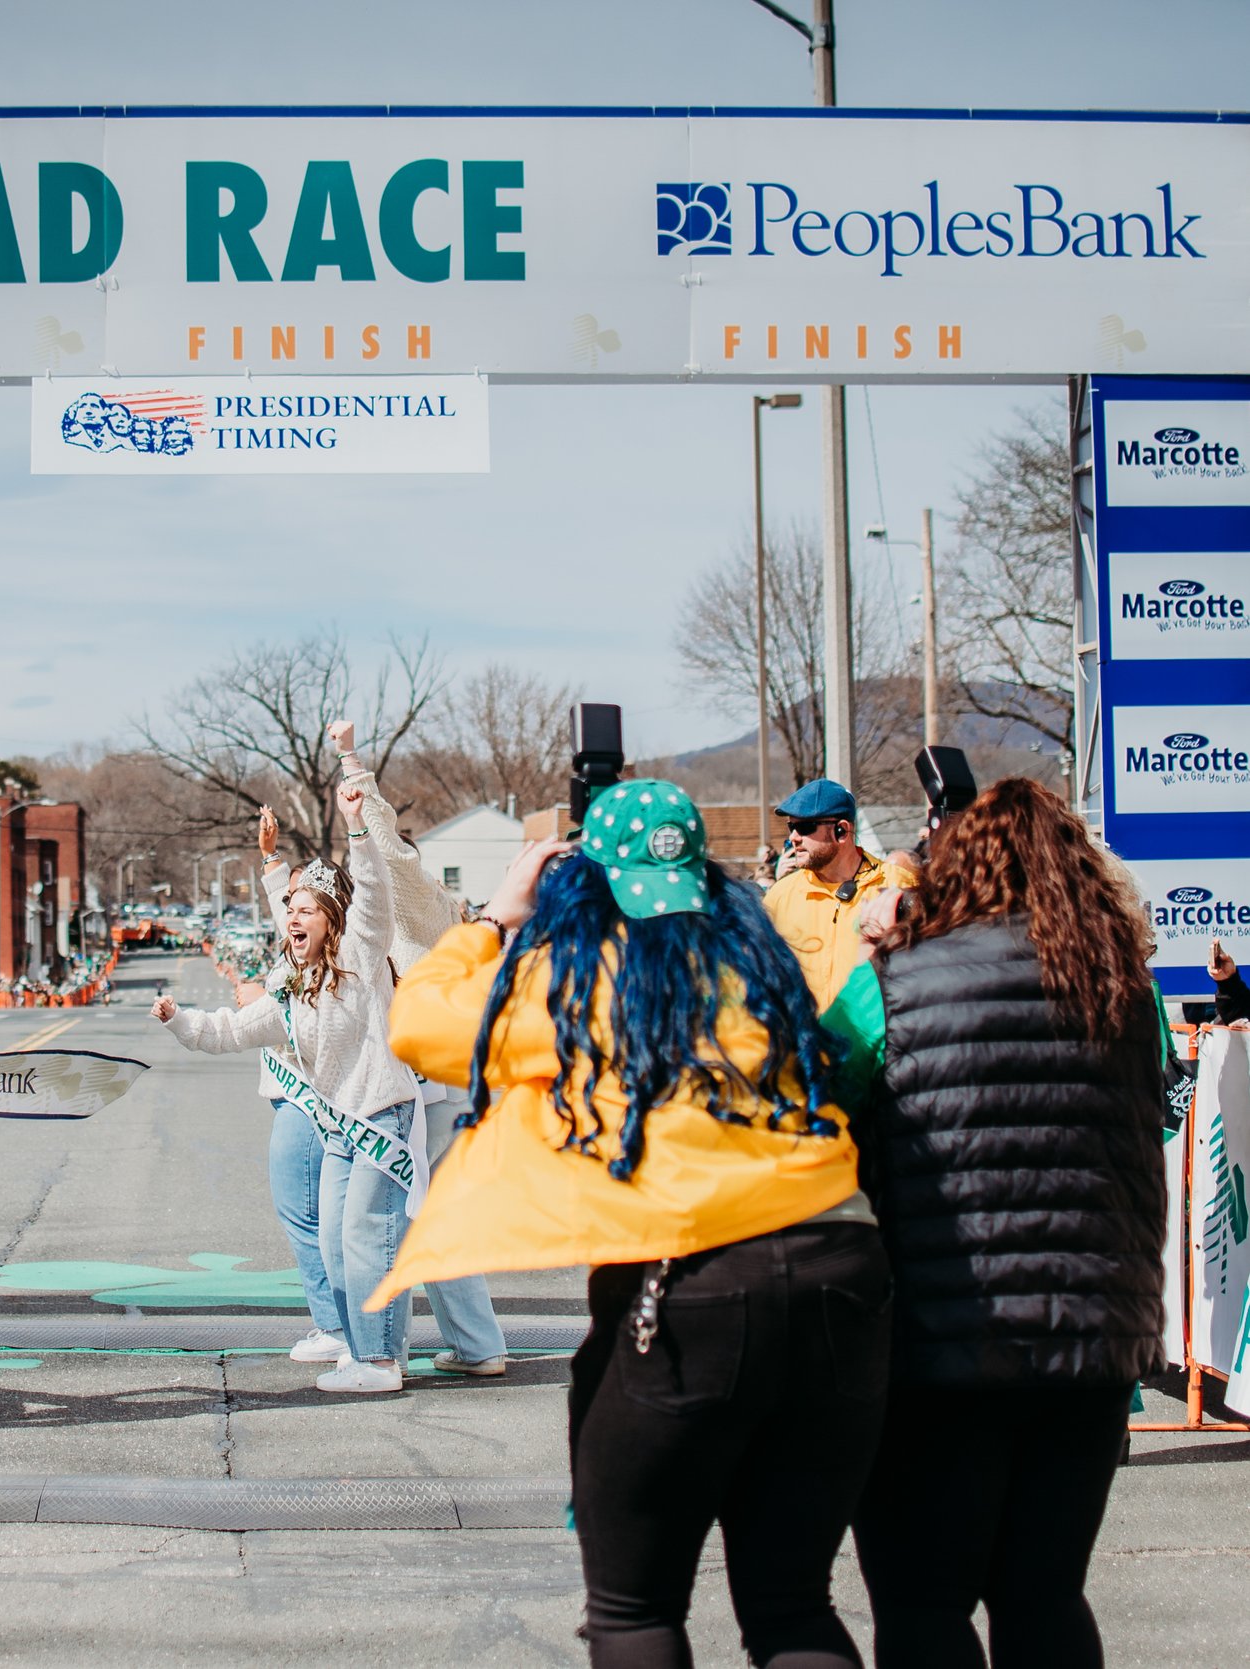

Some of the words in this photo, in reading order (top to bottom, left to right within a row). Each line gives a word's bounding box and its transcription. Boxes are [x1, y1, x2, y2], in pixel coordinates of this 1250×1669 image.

[186, 158, 526, 283] RACE
[747, 180, 1208, 277] PeoplesBank
[188, 324, 432, 360] FINISH
[724, 324, 962, 360] FINISH
[214, 395, 457, 418] PRESIDENTIAL
[211, 427, 338, 449] TIMING
[1117, 440, 1240, 466] Marcotte
[1122, 593, 1244, 619] Marcotte
[1126, 747, 1248, 772] Marcotte
[1143, 901, 1250, 926] arcotte
[1194, 925, 1208, 935] Got
[1212, 926, 1234, 937] Your
[311, 1089, 392, 1163] OLLEEN
